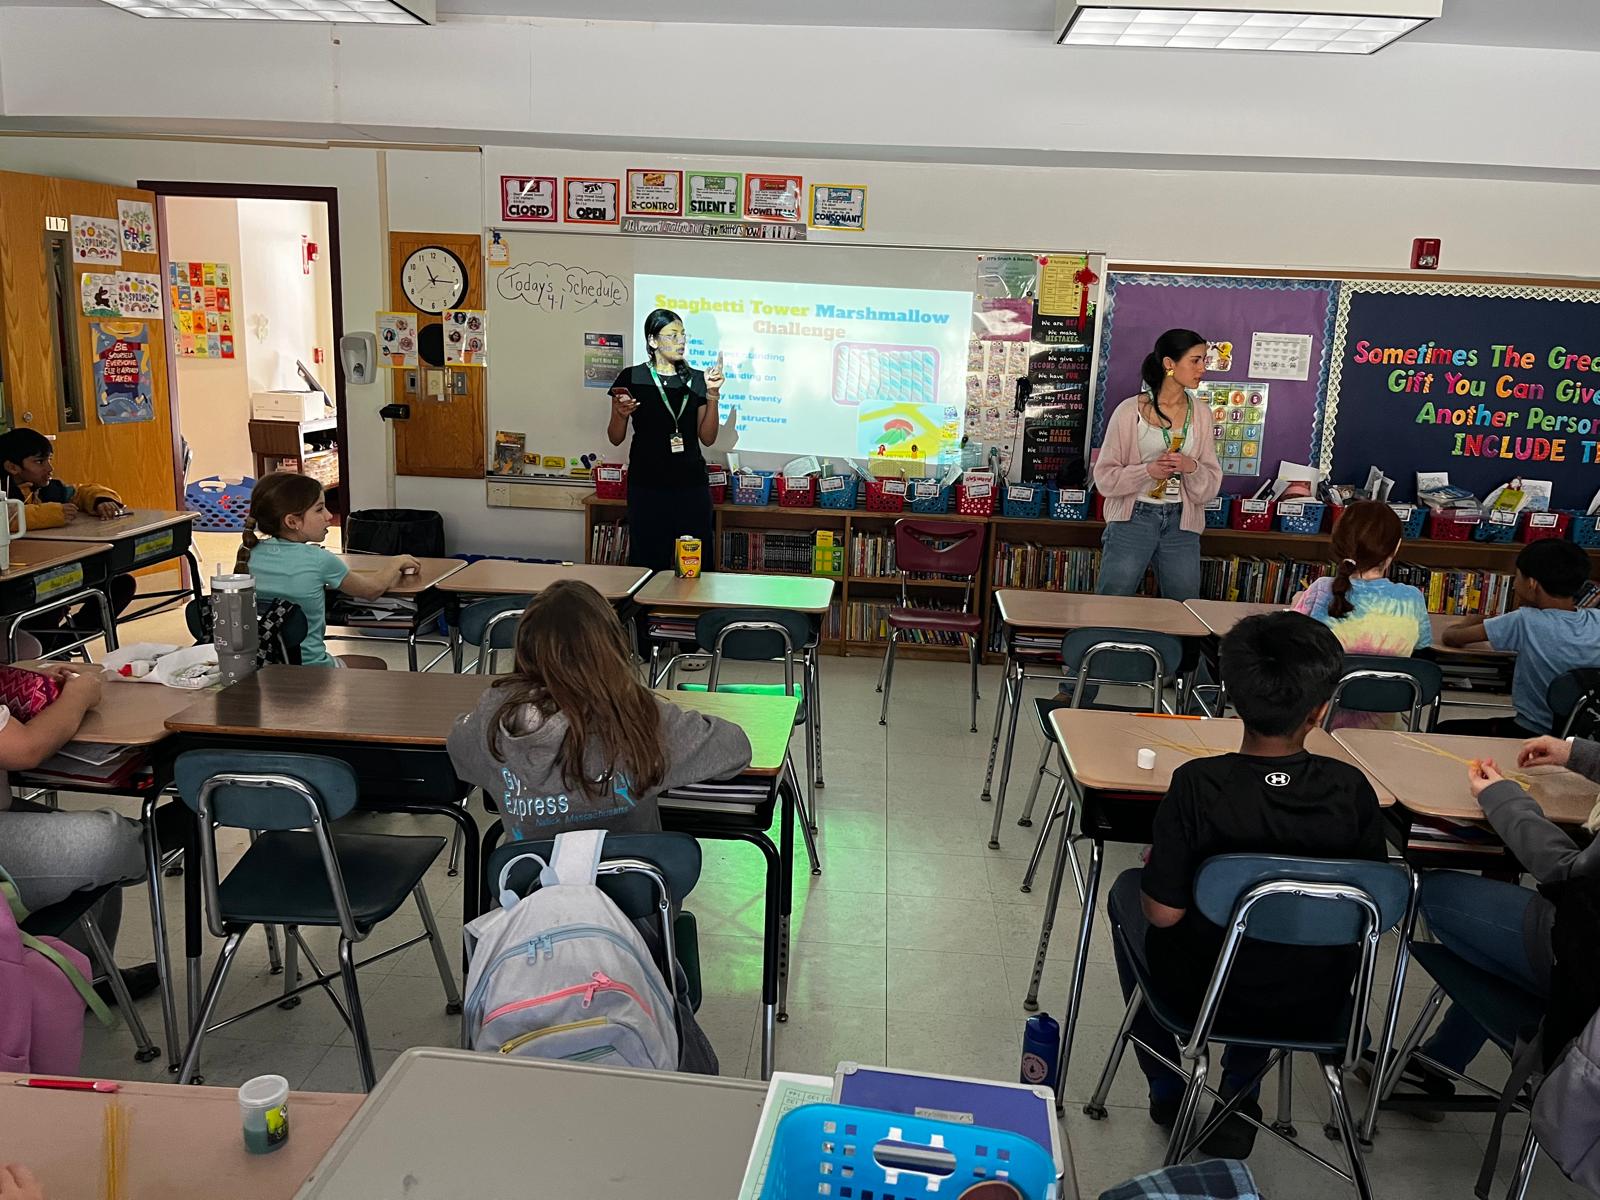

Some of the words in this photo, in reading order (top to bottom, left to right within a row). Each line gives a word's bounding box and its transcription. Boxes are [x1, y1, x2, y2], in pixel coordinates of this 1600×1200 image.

[508, 204, 550, 216] CLOSED
[631, 200, 678, 211] R-CONTROL
[690, 200, 727, 213] SILENT
[729, 202, 736, 214] E
[576, 207, 606, 219] OPEN
[748, 207, 773, 216] VOWEL
[814, 213, 862, 223] CONSONANT
[48, 217, 66, 230] 117
[84, 238, 108, 248] SPRING
[504, 272, 553, 303] Today's
[566, 273, 622, 301] Schedule
[128, 292, 150, 303] SPRING
[420, 298, 424, 306] 7
[655, 294, 744, 314] Spaghetti
[750, 299, 809, 317] Tower
[815, 303, 950, 325] Marshmallow
[753, 319, 846, 341] Challenge
[1045, 334, 1080, 343] MISTAKES.
[113, 342, 128, 352] BE
[689, 348, 705, 356] the
[1047, 354, 1058, 362] We
[1059, 355, 1073, 364] give
[1353, 340, 1479, 367] Sometimes
[1490, 344, 1536, 369] The
[105, 359, 138, 368] EVERYONE
[1030, 361, 1056, 370] SECOND
[1049, 372, 1064, 380] have
[1387, 368, 1435, 394] Gift
[1444, 371, 1487, 397] You
[1495, 374, 1544, 400] Can
[748, 394, 783, 405] twenty
[1044, 394, 1056, 403] say
[1056, 393, 1082, 401] PLEASE
[741, 414, 788, 424] structure
[1215, 411, 1224, 419] 10
[1415, 402, 1519, 428] Another
[1049, 428, 1072, 436] RAISE
[1451, 432, 1567, 462] INCLUDE
